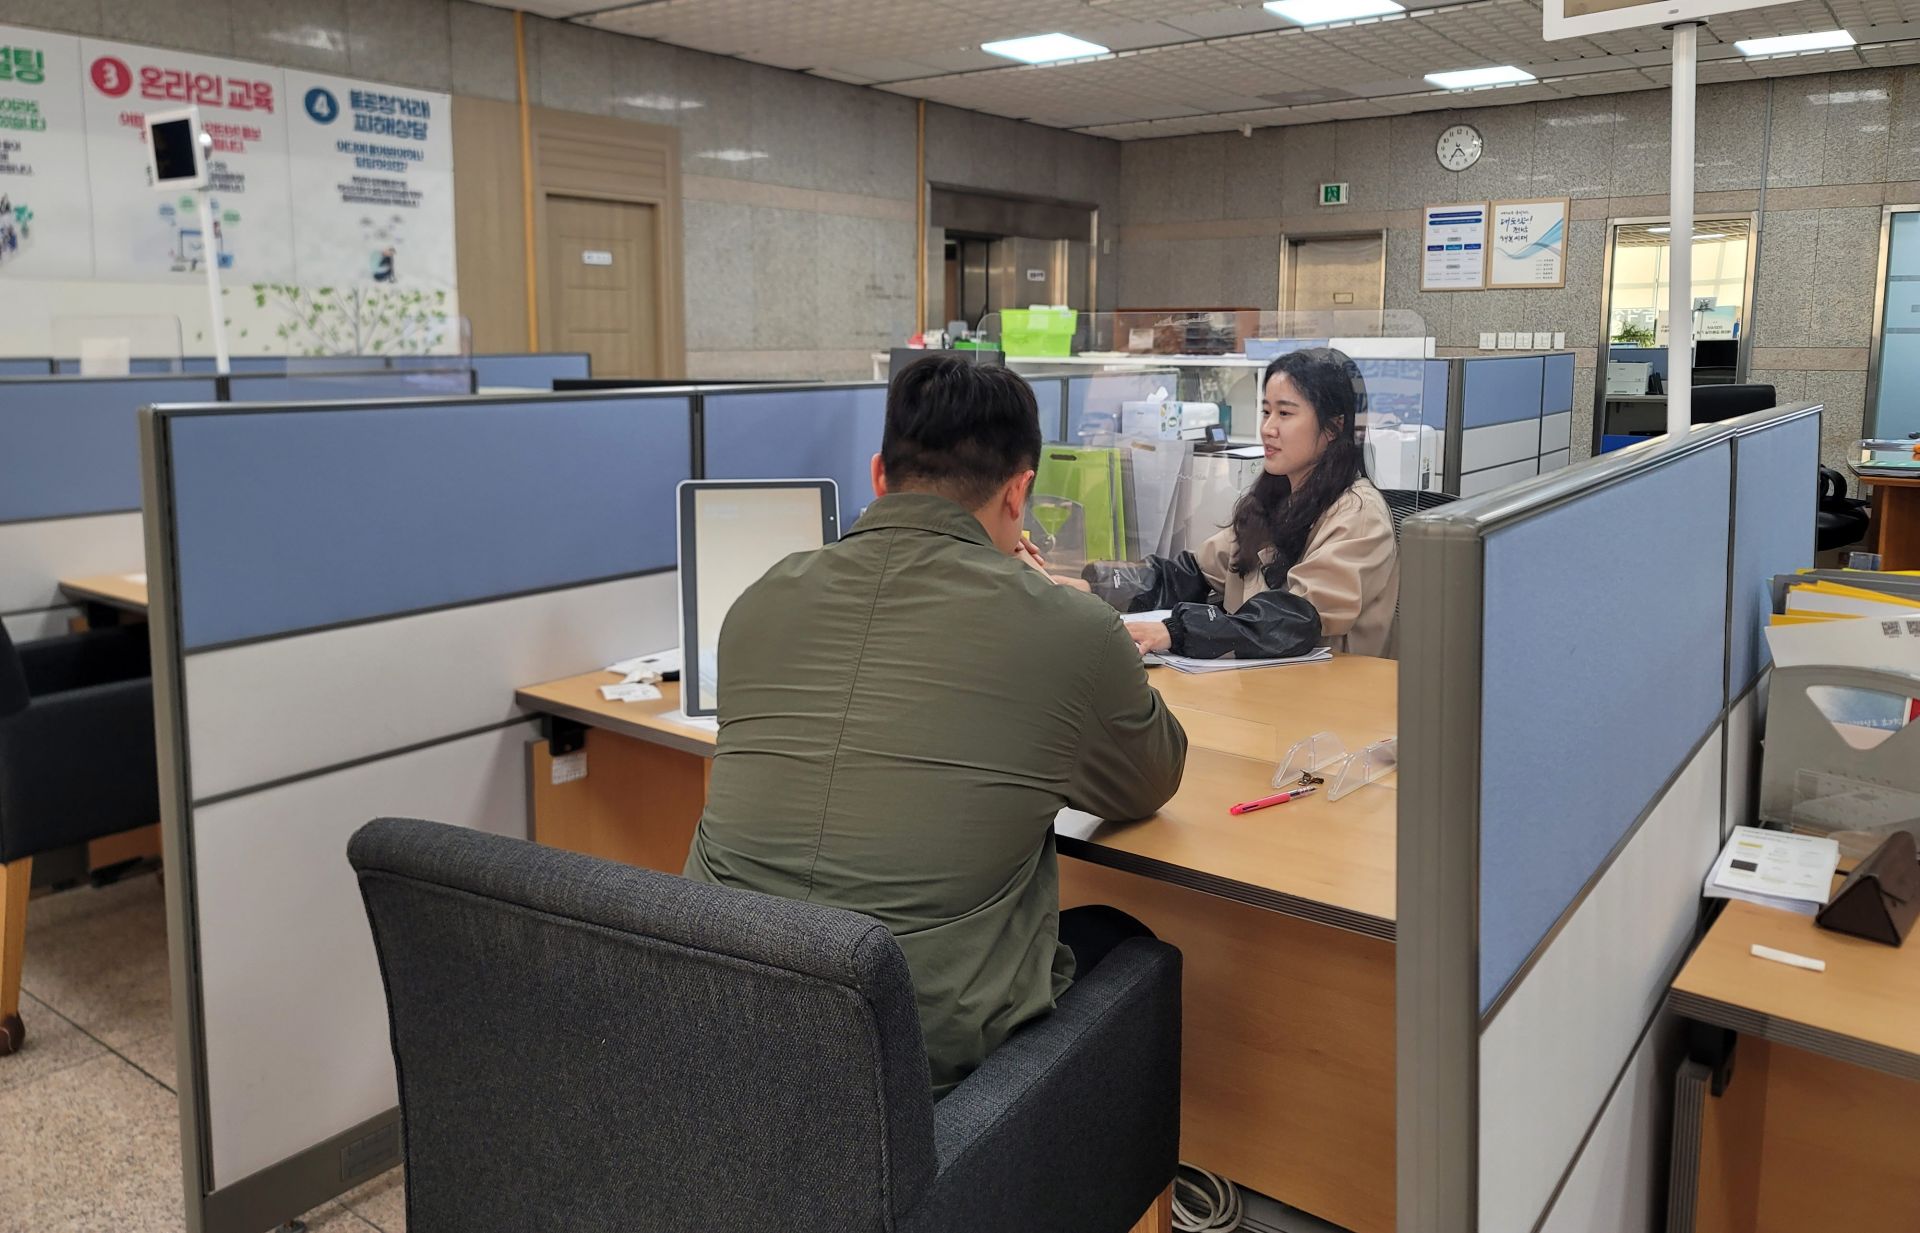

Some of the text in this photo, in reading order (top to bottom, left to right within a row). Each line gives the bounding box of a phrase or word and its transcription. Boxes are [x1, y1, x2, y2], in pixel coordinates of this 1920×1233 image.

[102, 62, 274, 114] 3 온라인 교육
[313, 94, 331, 117] 4
[354, 113, 428, 141] 피해상담
